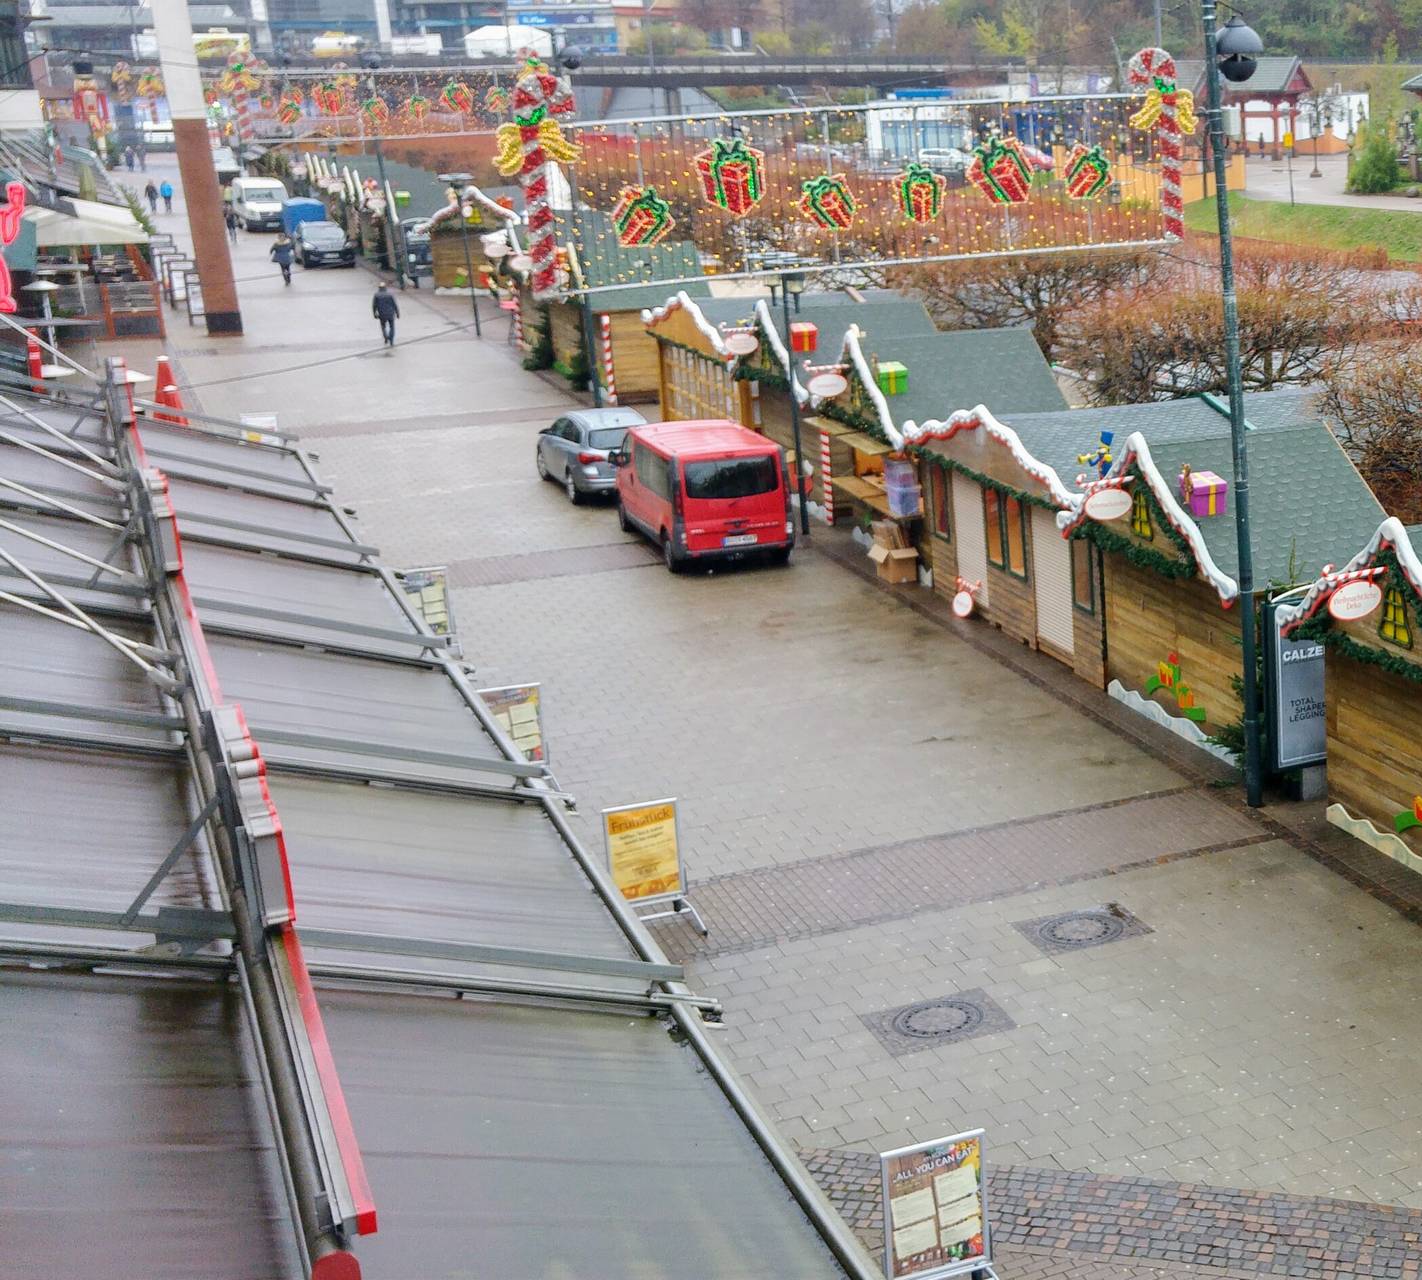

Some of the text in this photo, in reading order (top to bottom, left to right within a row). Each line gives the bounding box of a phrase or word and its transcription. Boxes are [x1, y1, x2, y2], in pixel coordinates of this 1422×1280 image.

[1282, 645, 1325, 662] CALZE
[1290, 696, 1315, 707] TOTAL
[915, 1160, 935, 1175] YOU
[936, 1152, 956, 1167] CAN
